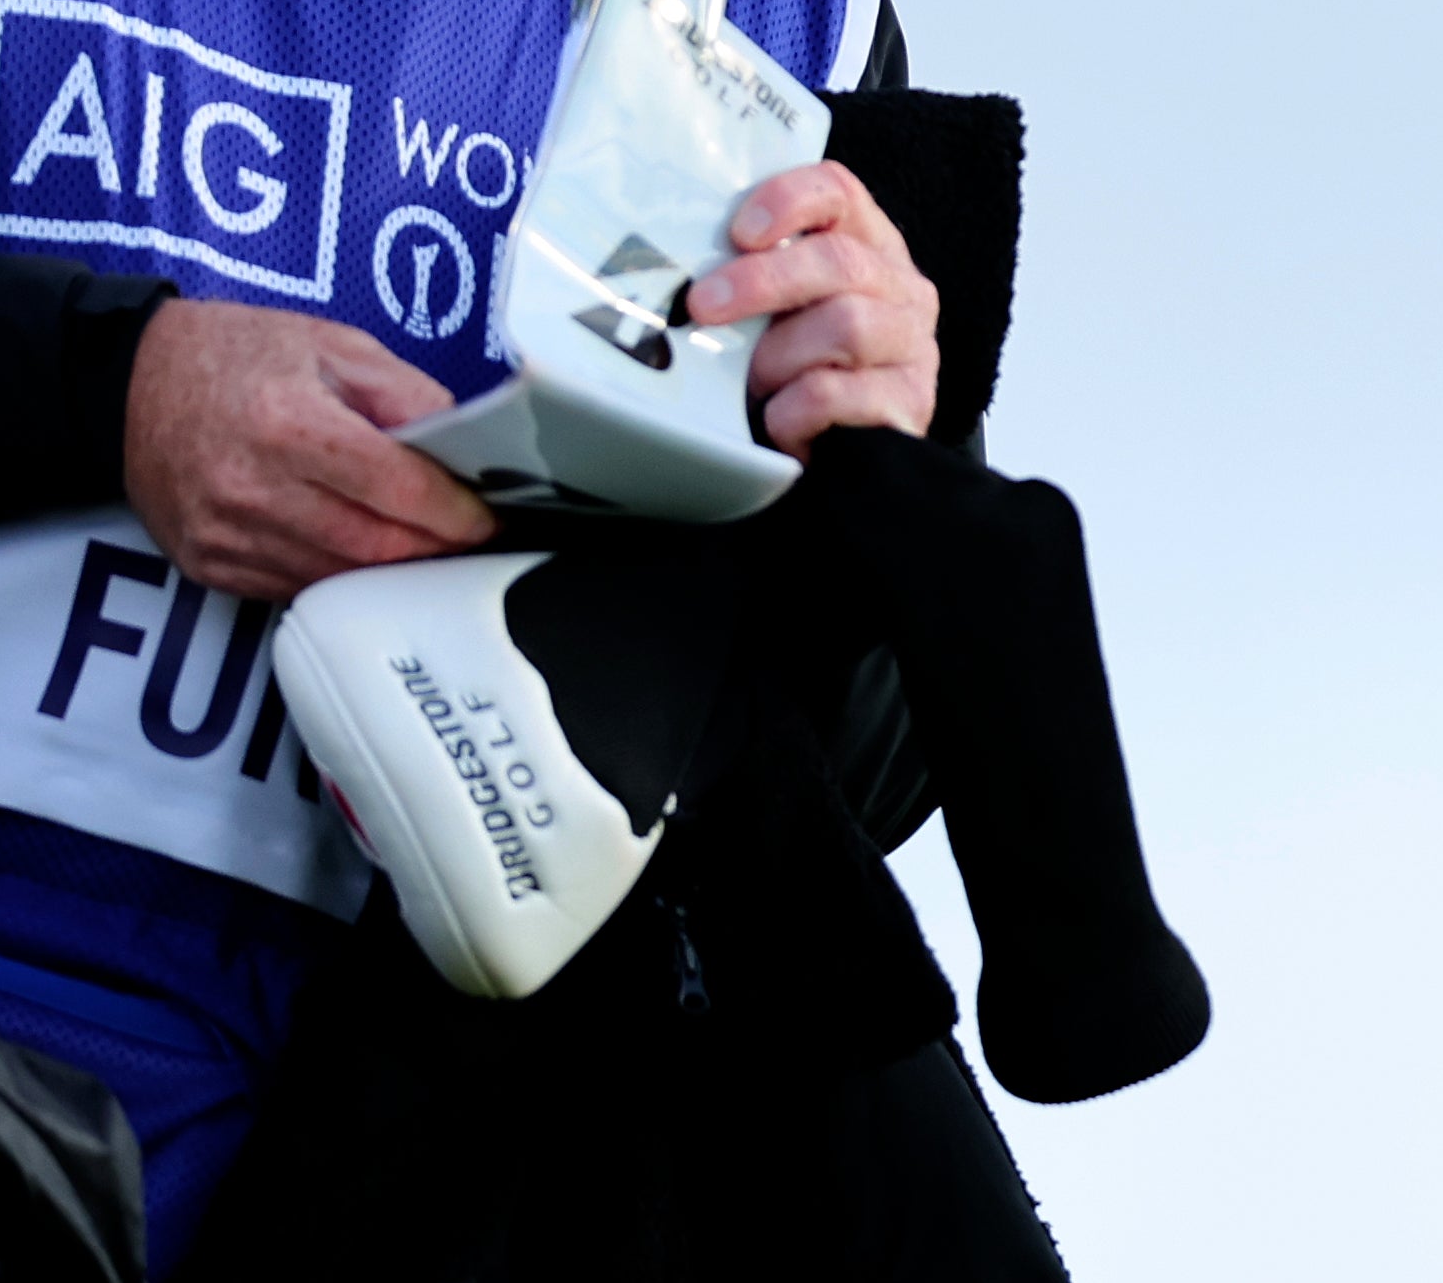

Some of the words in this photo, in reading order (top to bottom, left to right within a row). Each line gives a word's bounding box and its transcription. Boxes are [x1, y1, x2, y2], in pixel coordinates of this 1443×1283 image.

[11, 51, 287, 234] AIG
[393, 97, 536, 208] WO
[388, 654, 543, 901] BRIDGESTONE
[462, 692, 555, 829] GOLF
